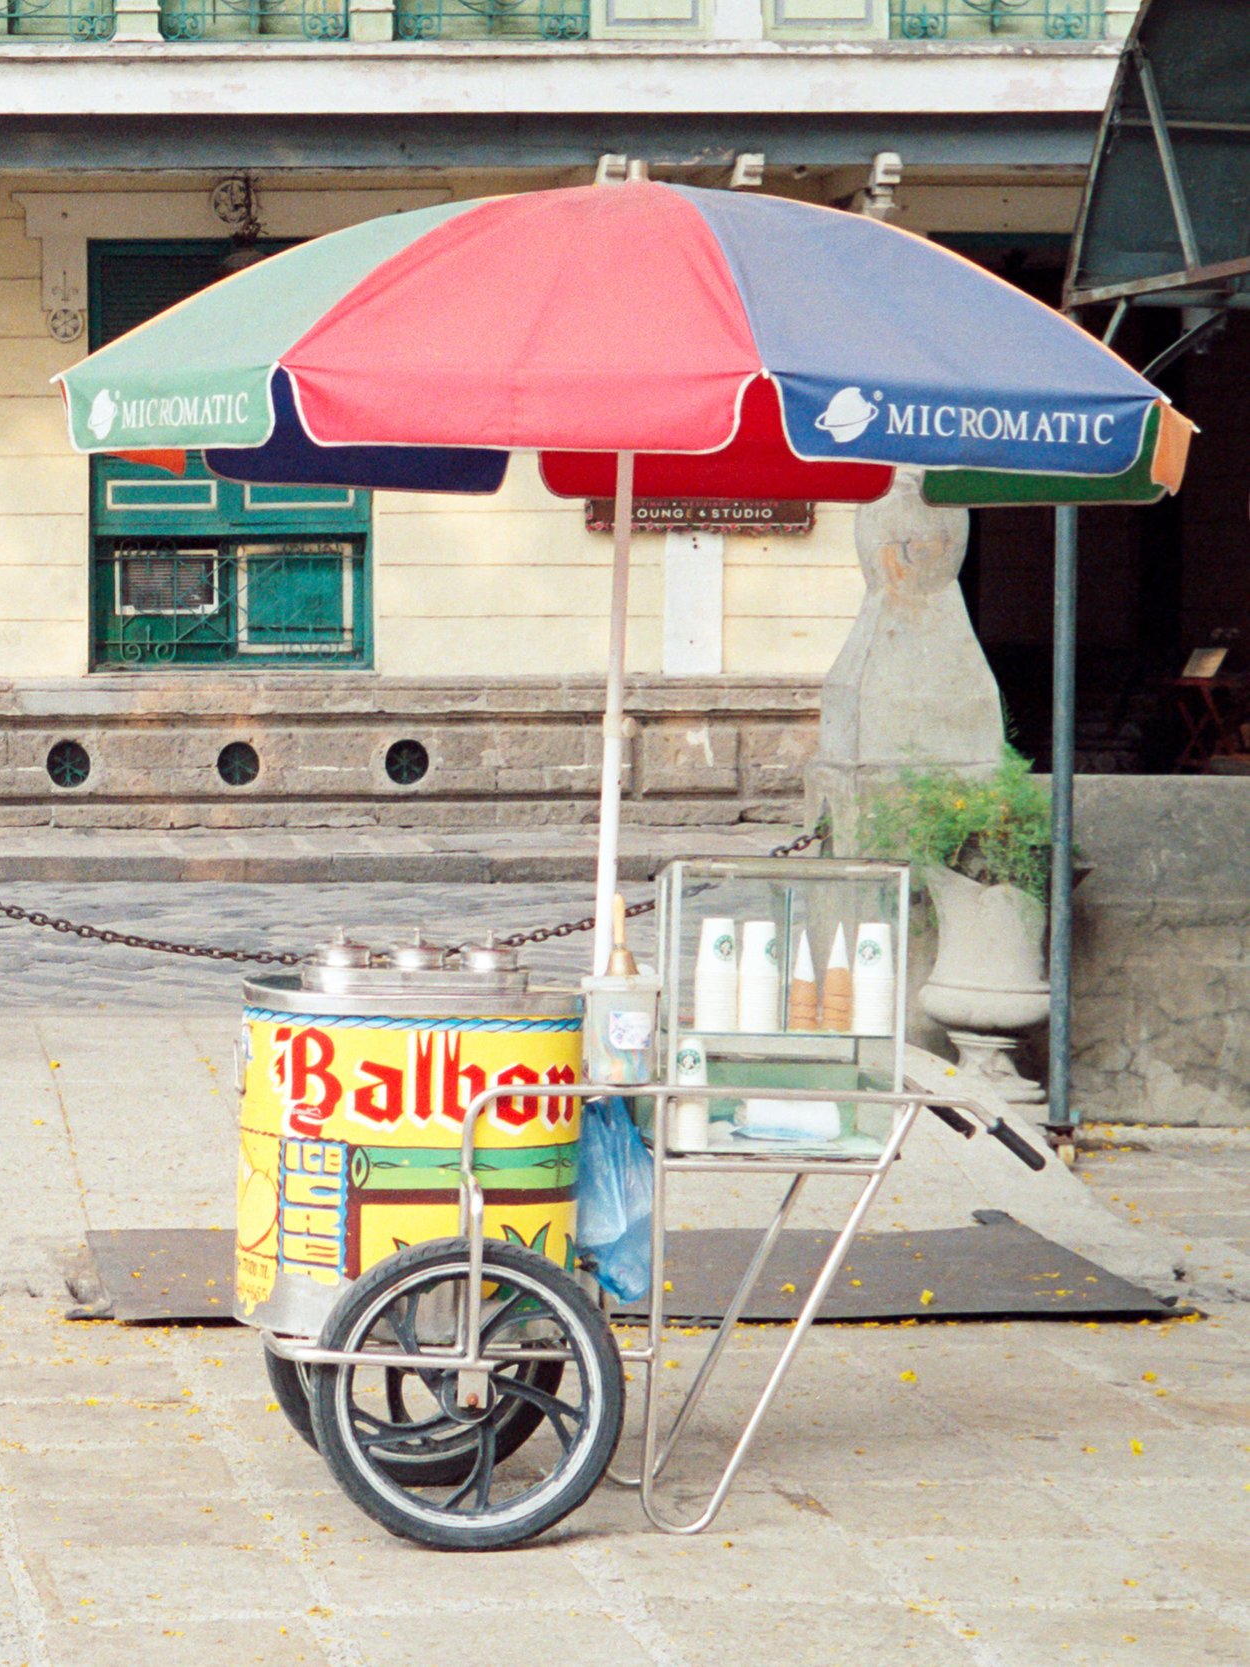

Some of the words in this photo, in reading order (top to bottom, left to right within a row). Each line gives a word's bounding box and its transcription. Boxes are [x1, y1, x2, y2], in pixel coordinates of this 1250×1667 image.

[121, 391, 250, 430] MICROMATIC
[885, 402, 1116, 445] MICROMATIC
[630, 507, 693, 519] OUNGE
[711, 507, 773, 519] STUDIO
[273, 1026, 576, 1139] Balbon
[284, 1141, 343, 1174] ICE
